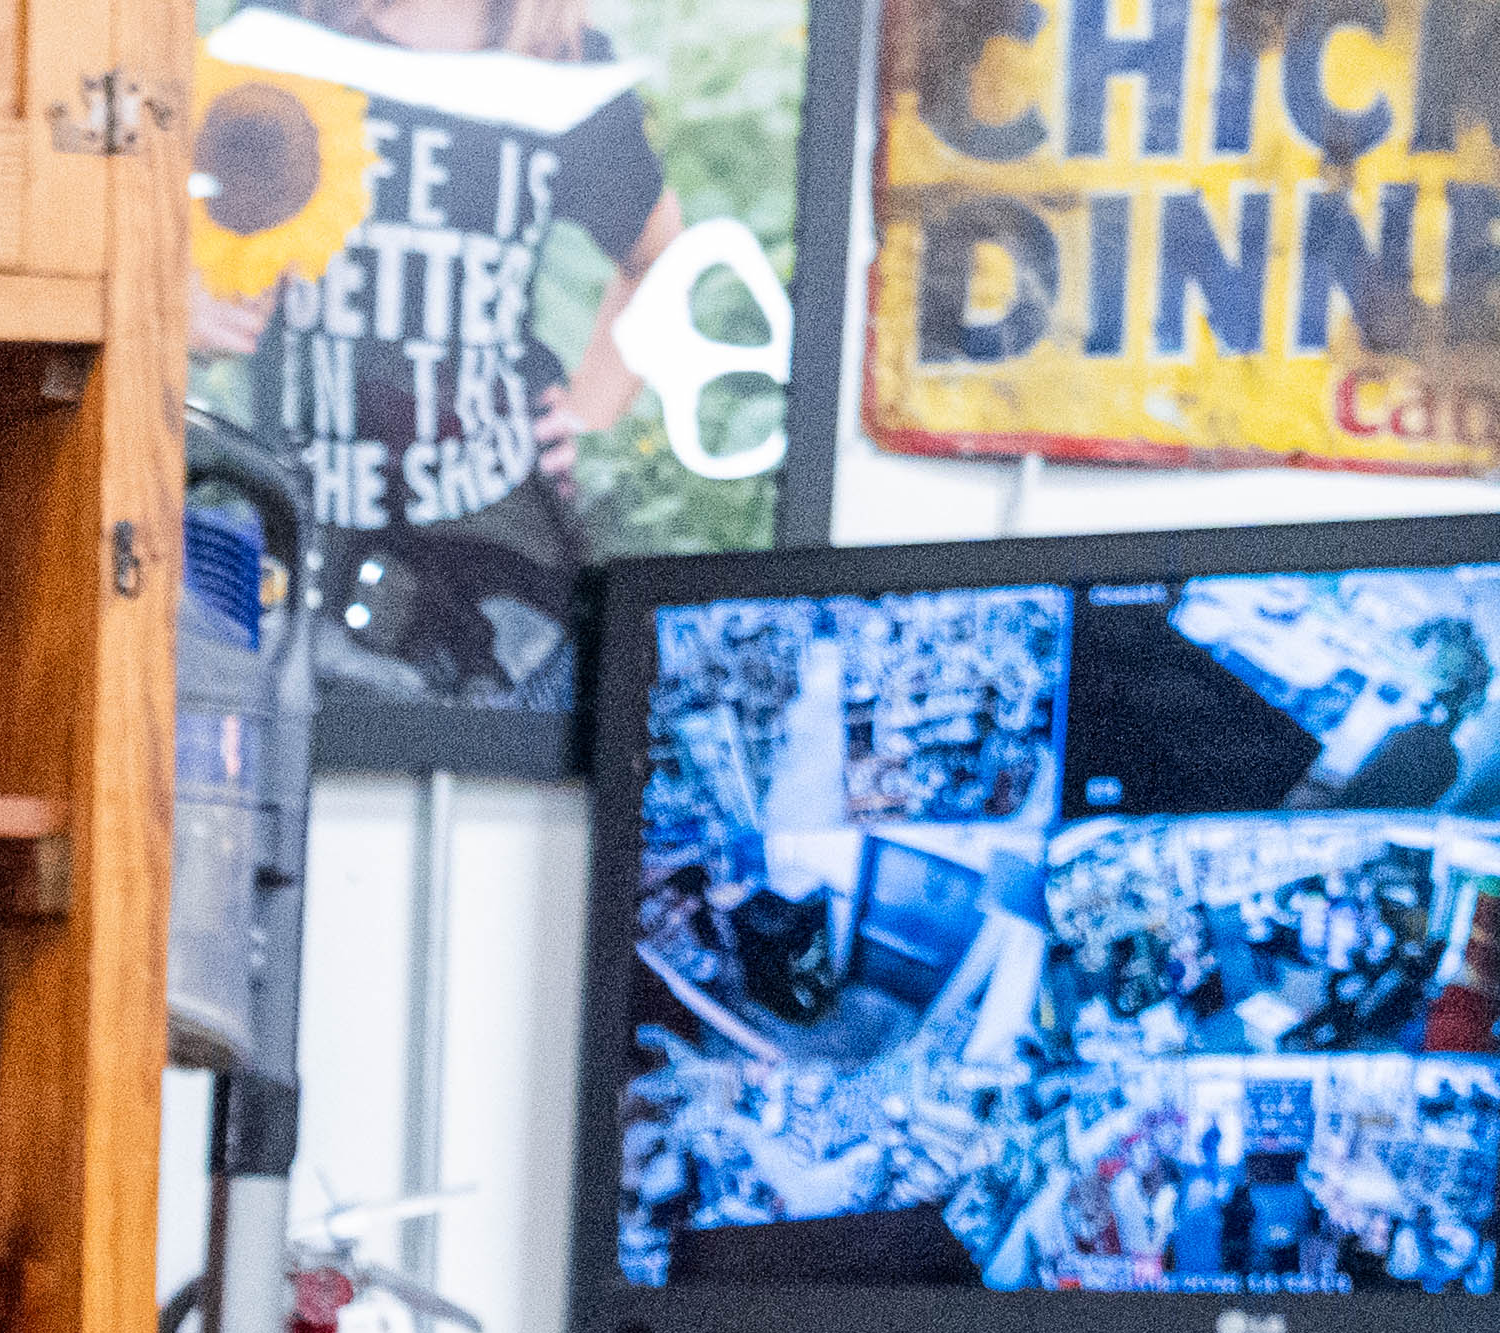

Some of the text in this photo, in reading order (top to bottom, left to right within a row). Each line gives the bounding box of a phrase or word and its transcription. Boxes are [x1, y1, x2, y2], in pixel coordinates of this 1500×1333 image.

[362, 118, 451, 227] FE
[281, 330, 357, 441] IN
[301, 438, 391, 530] HE
